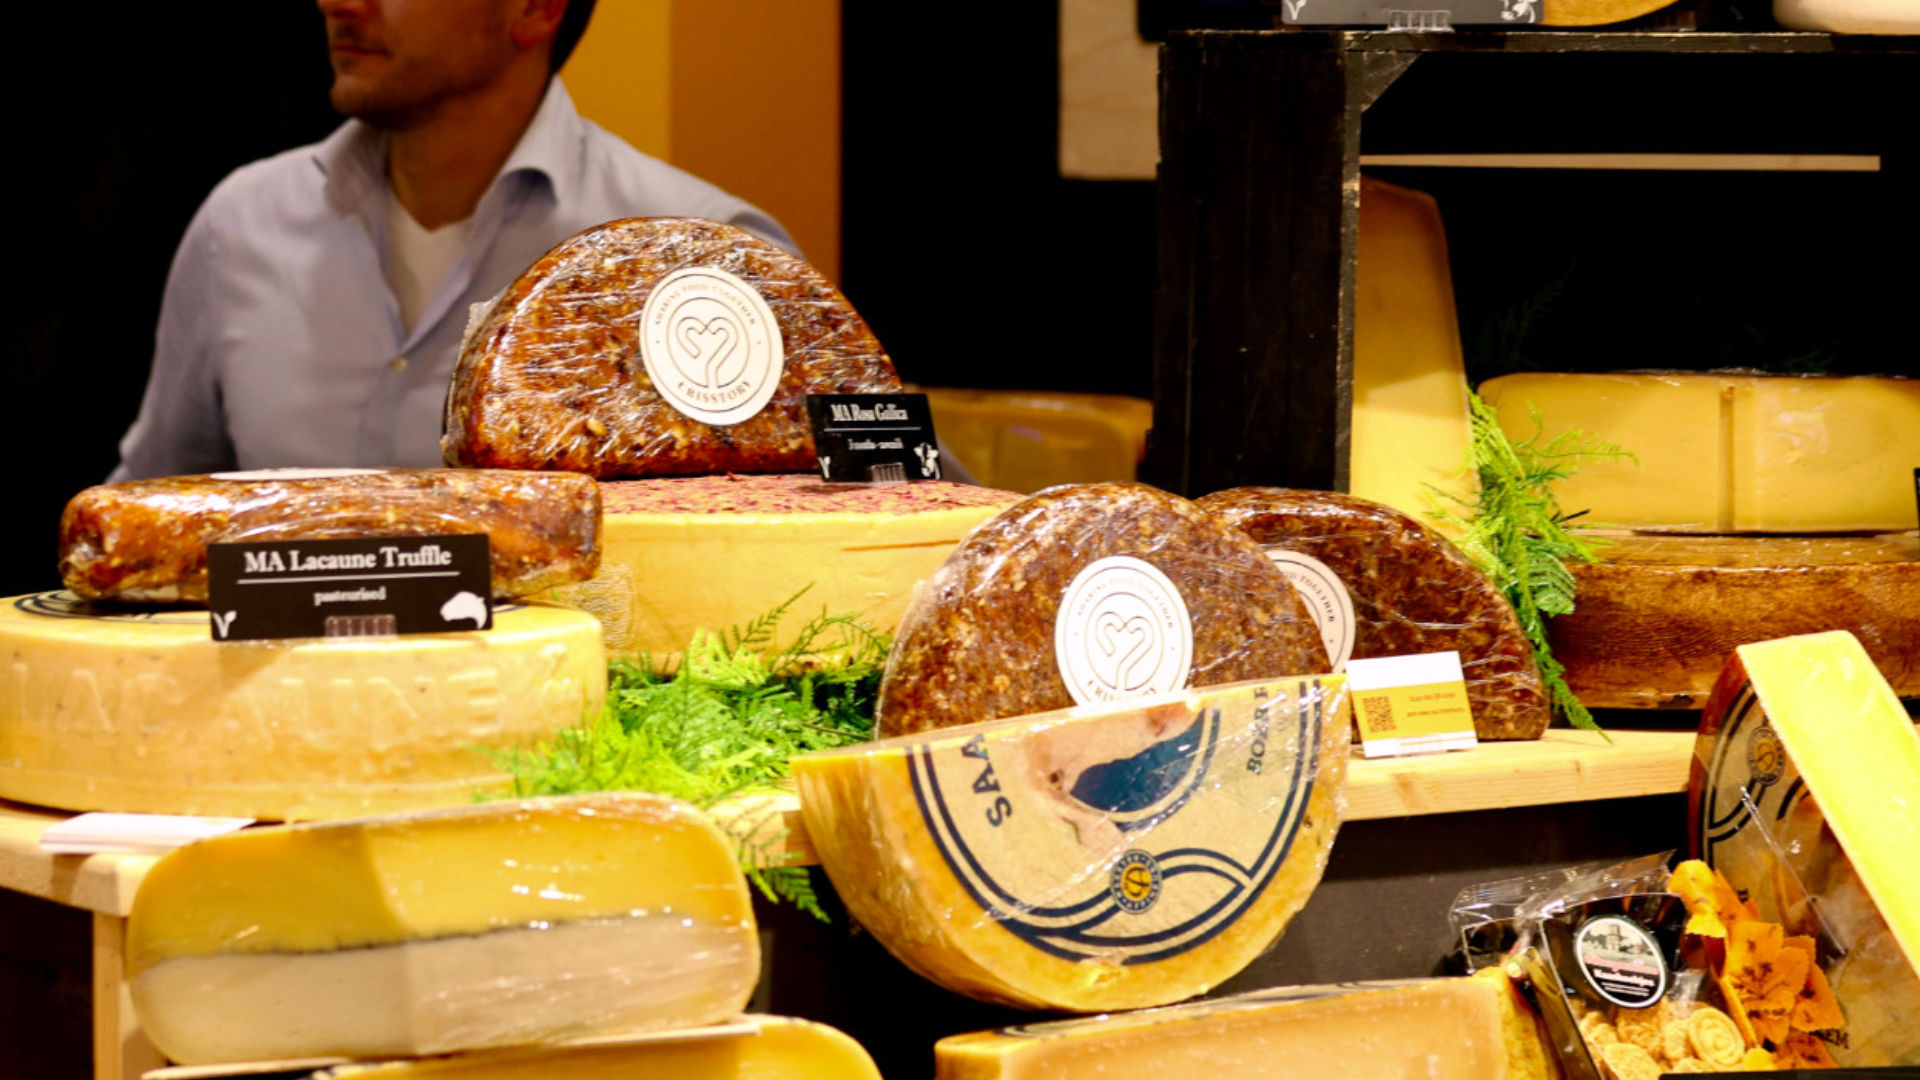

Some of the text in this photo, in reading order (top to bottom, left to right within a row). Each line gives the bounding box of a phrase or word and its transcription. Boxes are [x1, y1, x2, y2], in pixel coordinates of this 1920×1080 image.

[244, 545, 452, 572] MA Lacaune Truffle
[313, 586, 387, 606] pasteurised
